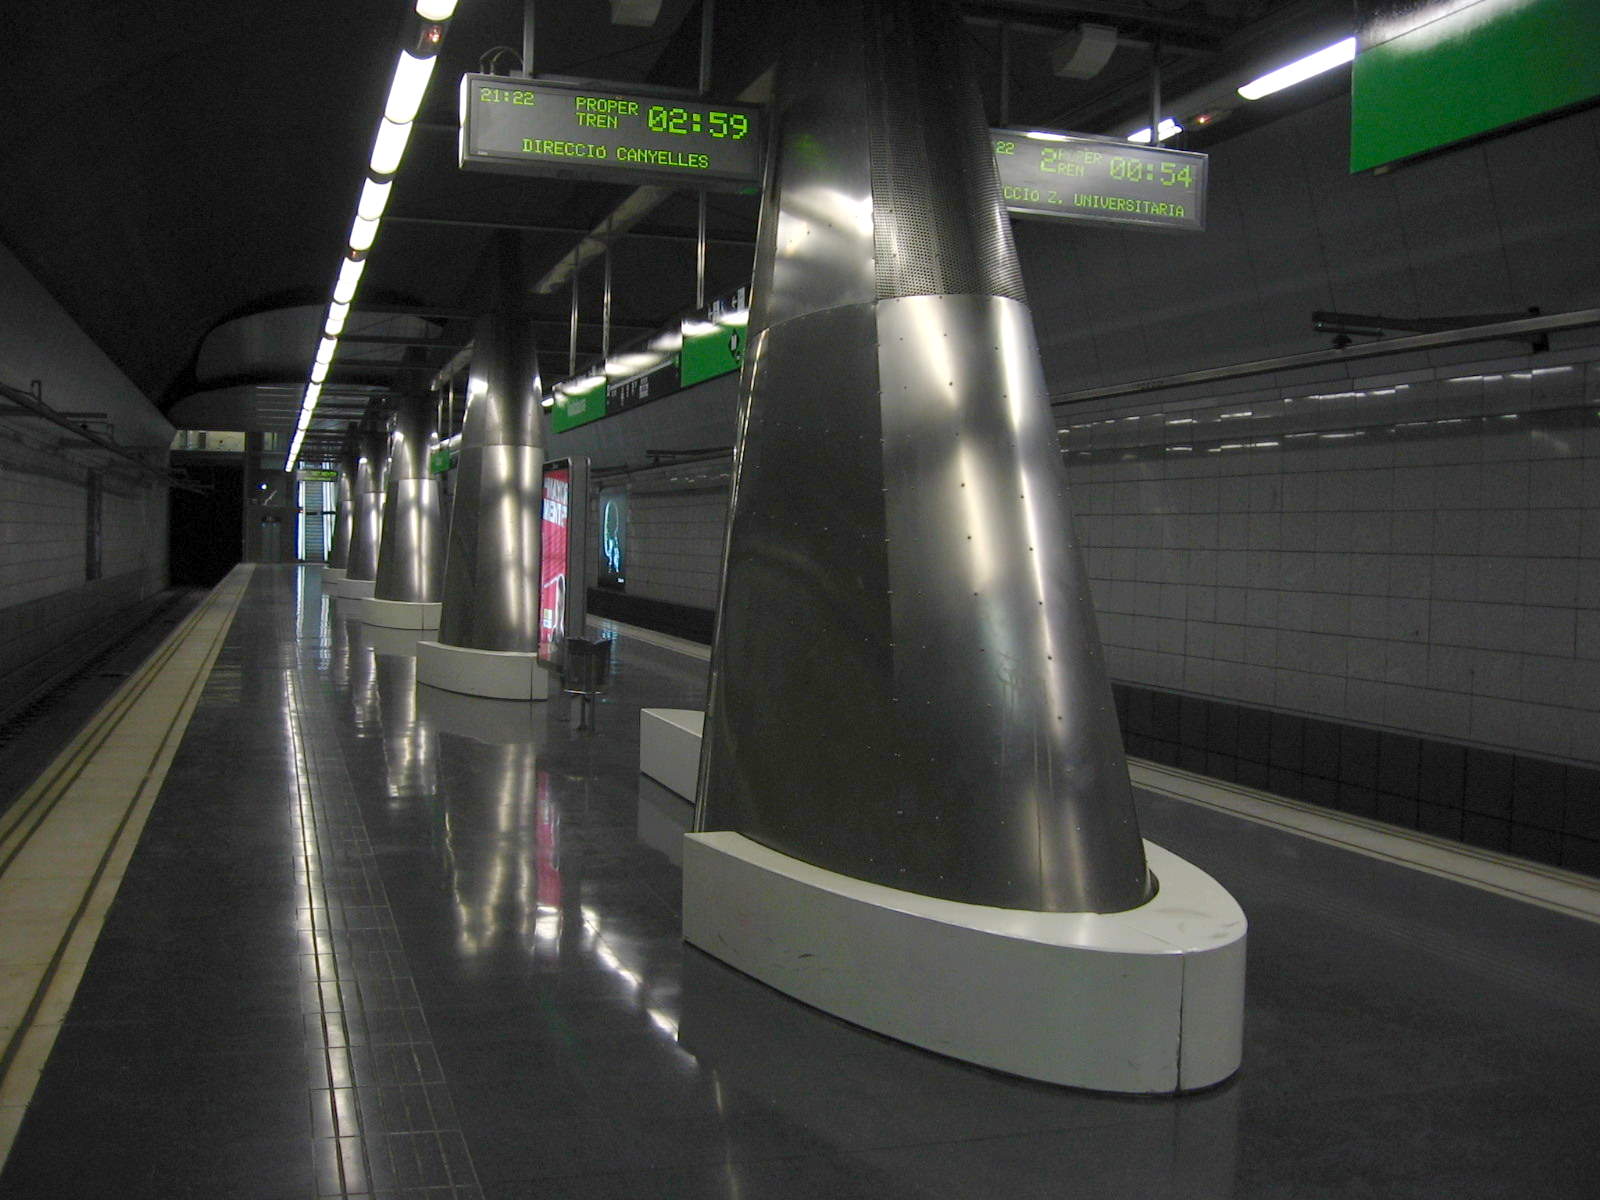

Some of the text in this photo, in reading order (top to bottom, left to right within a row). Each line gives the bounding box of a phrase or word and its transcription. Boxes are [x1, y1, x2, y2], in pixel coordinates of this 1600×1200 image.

[480, 88, 536, 107] 21:22
[575, 96, 640, 116] PROPER
[576, 112, 619, 129] TREN
[647, 105, 749, 140] 02:59
[616, 146, 710, 169] CANYELLES
[1109, 157, 1193, 187] 00:54
[1047, 191, 1064, 205] Z.
